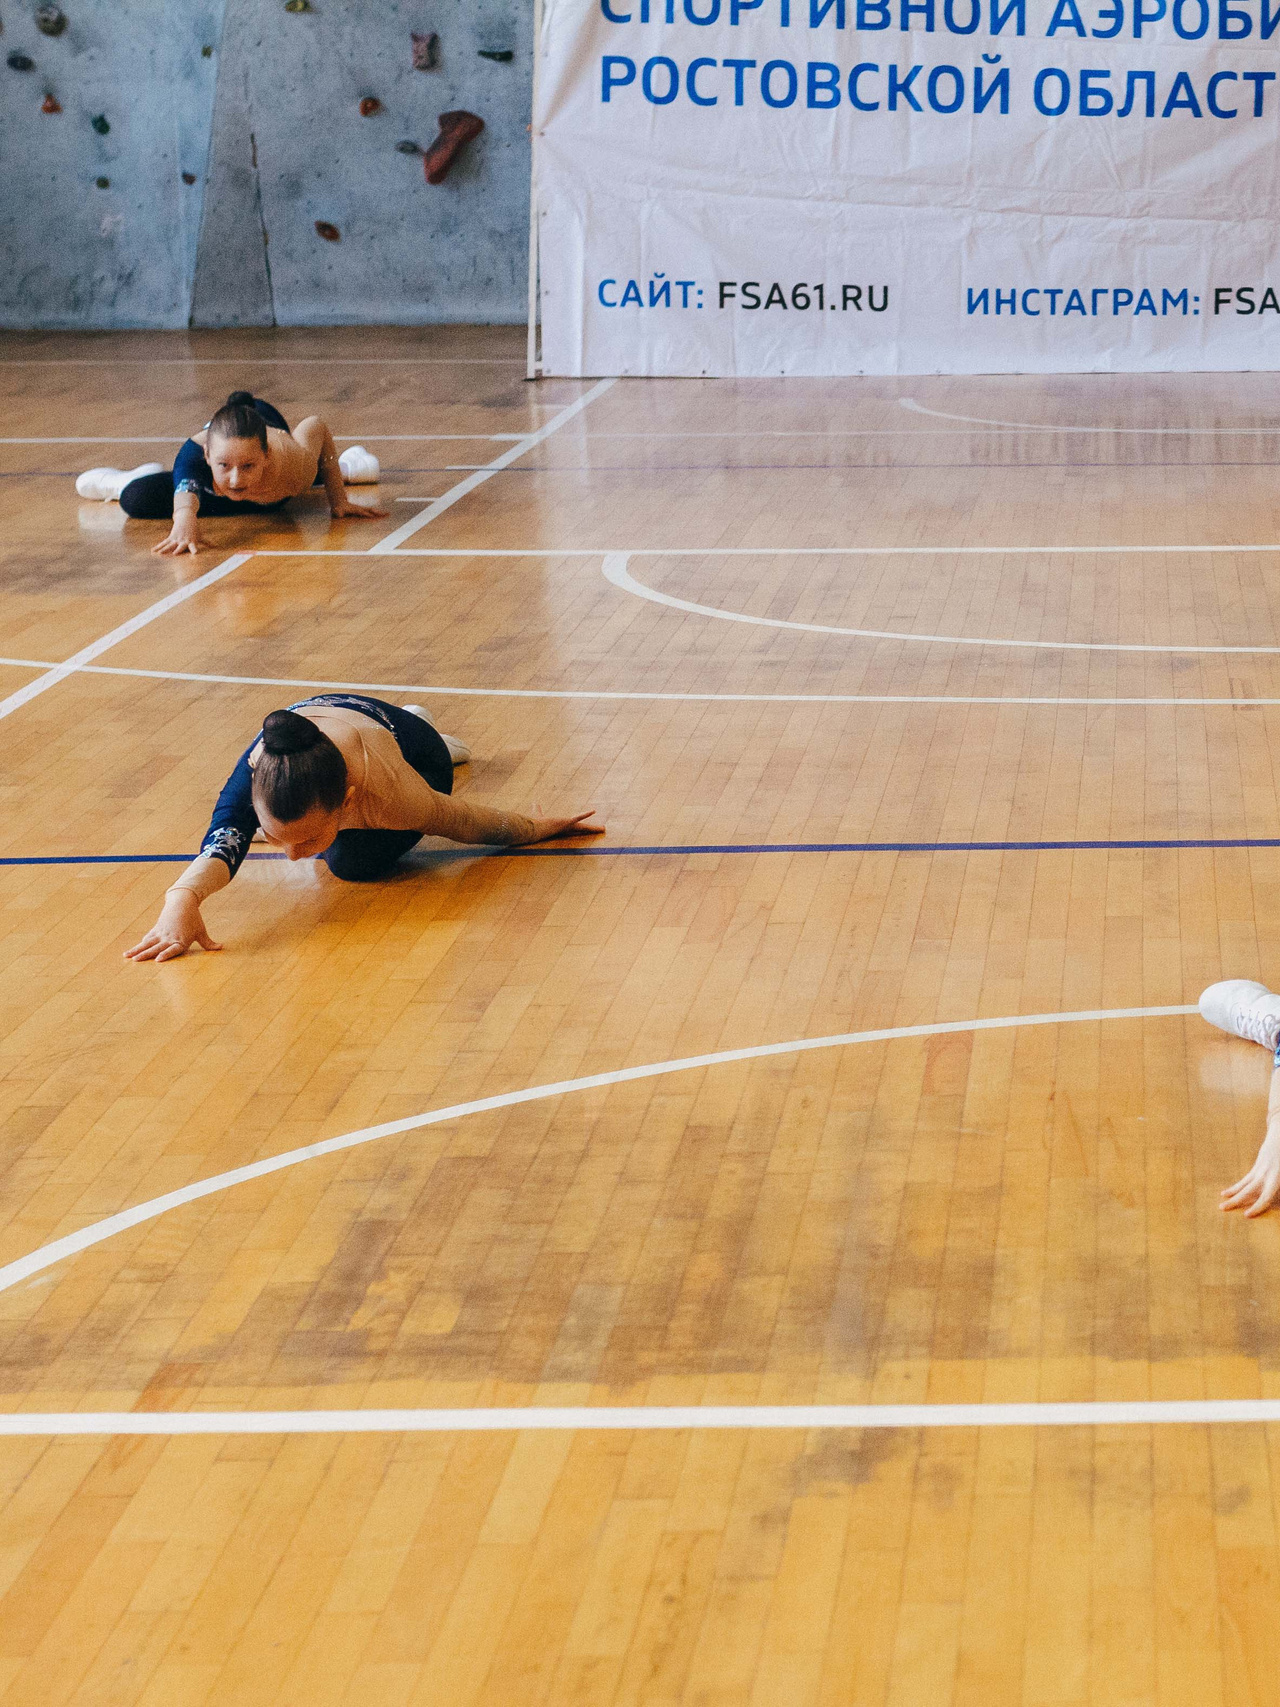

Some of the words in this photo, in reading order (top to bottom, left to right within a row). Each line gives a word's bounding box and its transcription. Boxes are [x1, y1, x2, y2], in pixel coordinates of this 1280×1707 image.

[600, 53, 1011, 116] РОСТОВСКОЙ
[597, 272, 704, 309] САЙТ:
[717, 281, 889, 313] FSA61.RU
[966, 287, 1200, 317] ИНСТАГРАМ:
